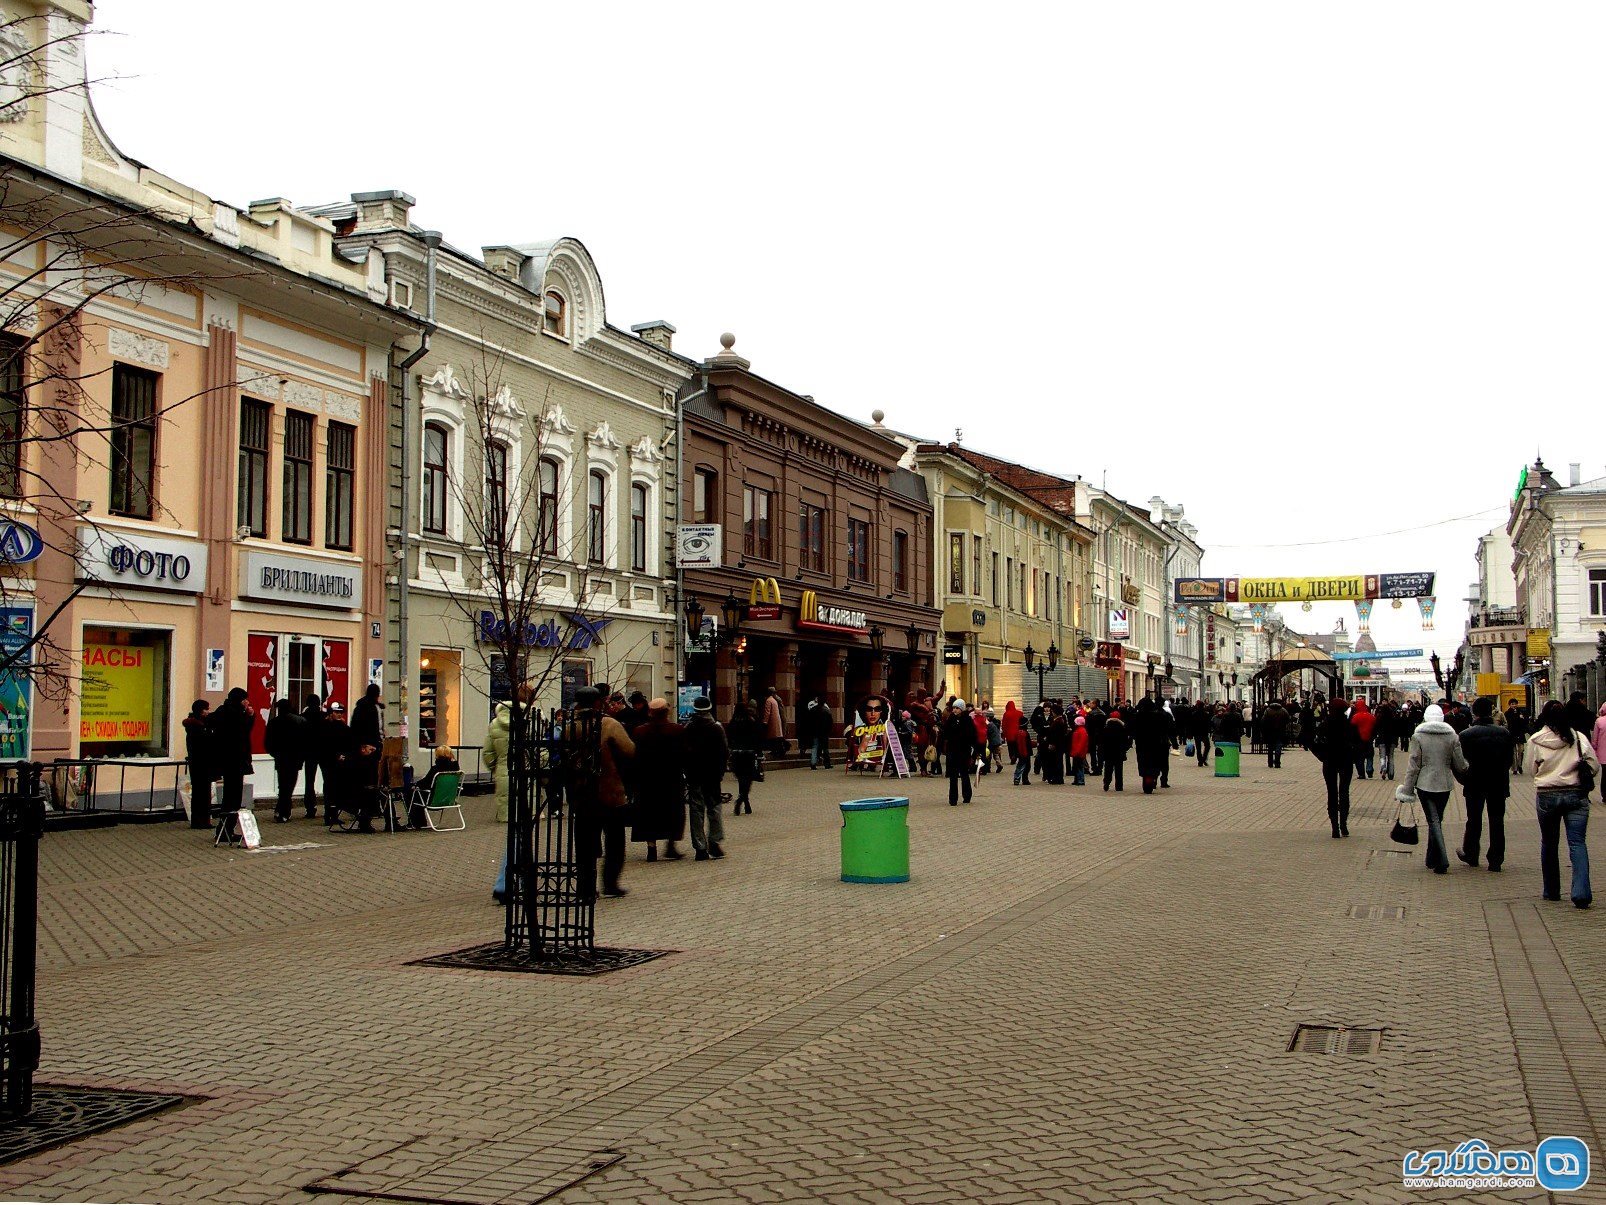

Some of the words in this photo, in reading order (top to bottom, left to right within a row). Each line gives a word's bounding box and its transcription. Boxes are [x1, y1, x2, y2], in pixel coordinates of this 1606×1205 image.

[110, 545, 190, 581] ФОТО
[262, 566, 354, 597] БРИЛЛИАНТЫ
[1243, 582, 1287, 598] ОКНА
[1292, 586, 1301, 598] и
[1306, 580, 1359, 600] ДВЕРИ
[855, 723, 886, 737] ОЧКИ
